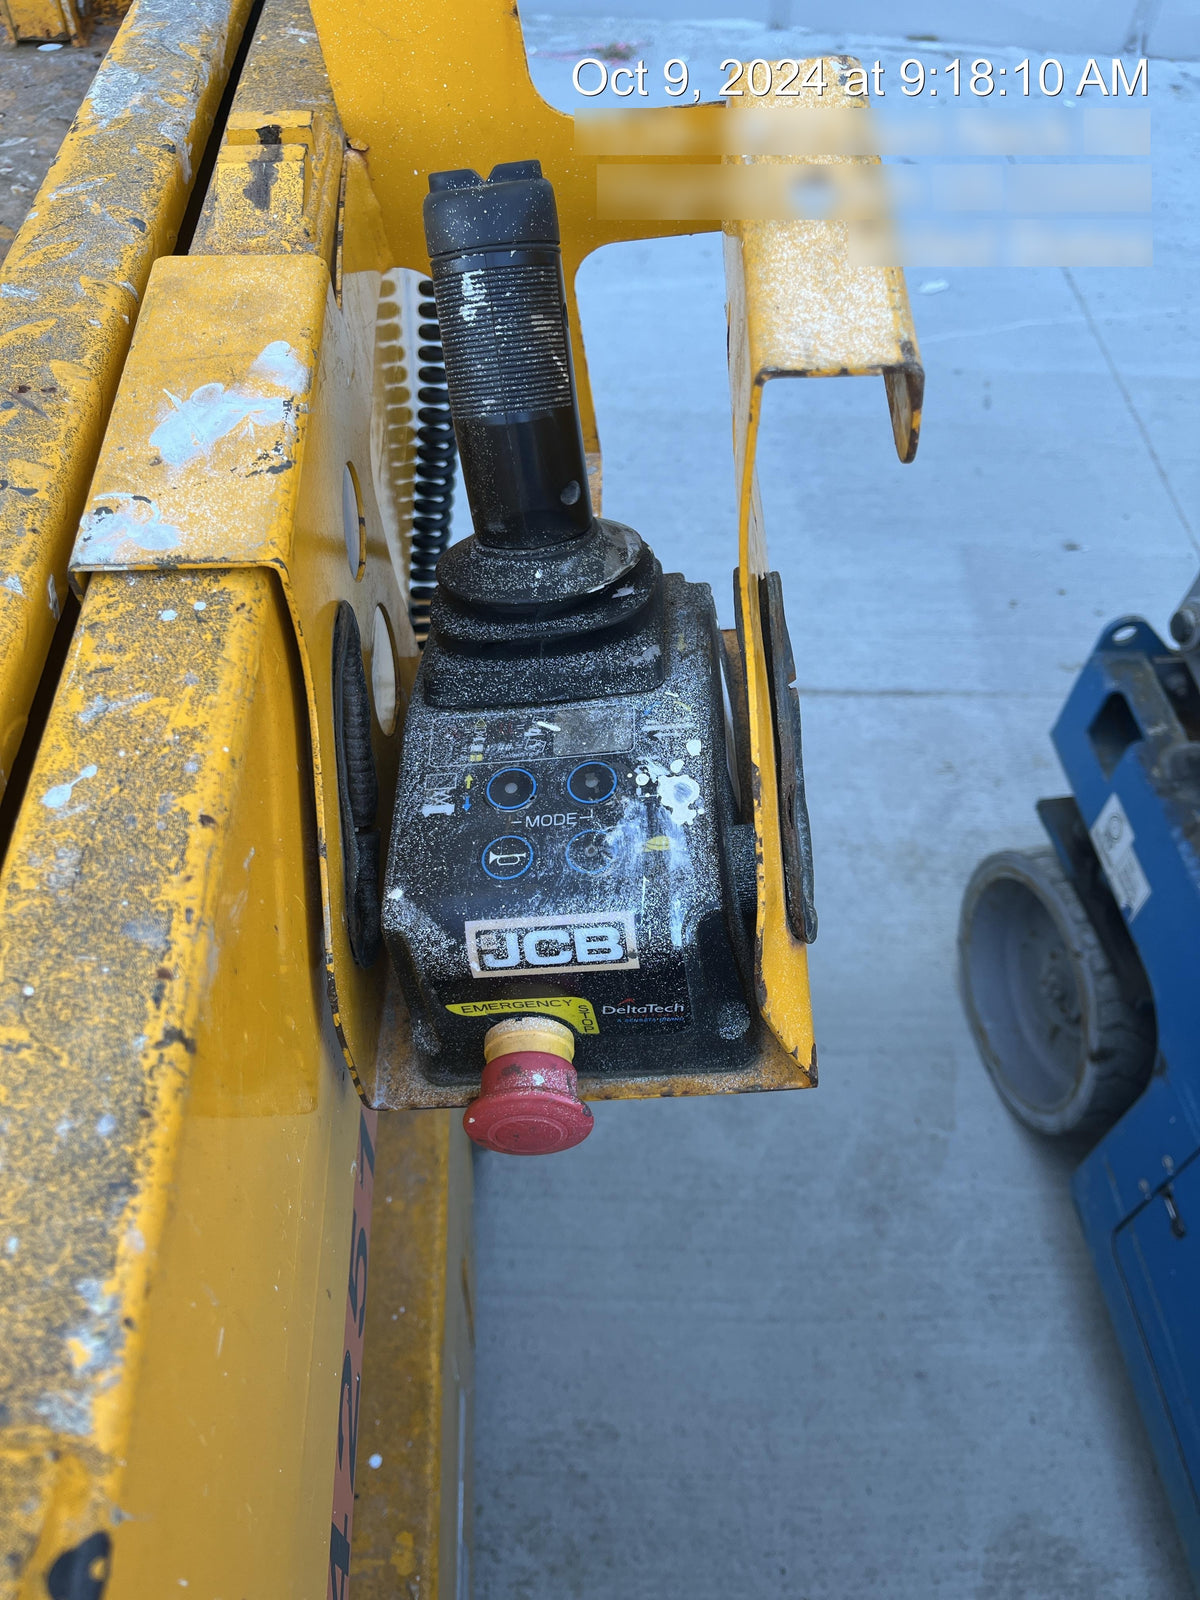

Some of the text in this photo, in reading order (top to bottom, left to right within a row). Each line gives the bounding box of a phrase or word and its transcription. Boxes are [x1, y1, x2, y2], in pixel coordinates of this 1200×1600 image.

[525, 812, 579, 829] MODE
[480, 927, 625, 970] JCB
[460, 999, 573, 1014] EMERGENCY
[602, 1003, 685, 1015] DeltaTech
[578, 1004, 595, 1033] STOP
